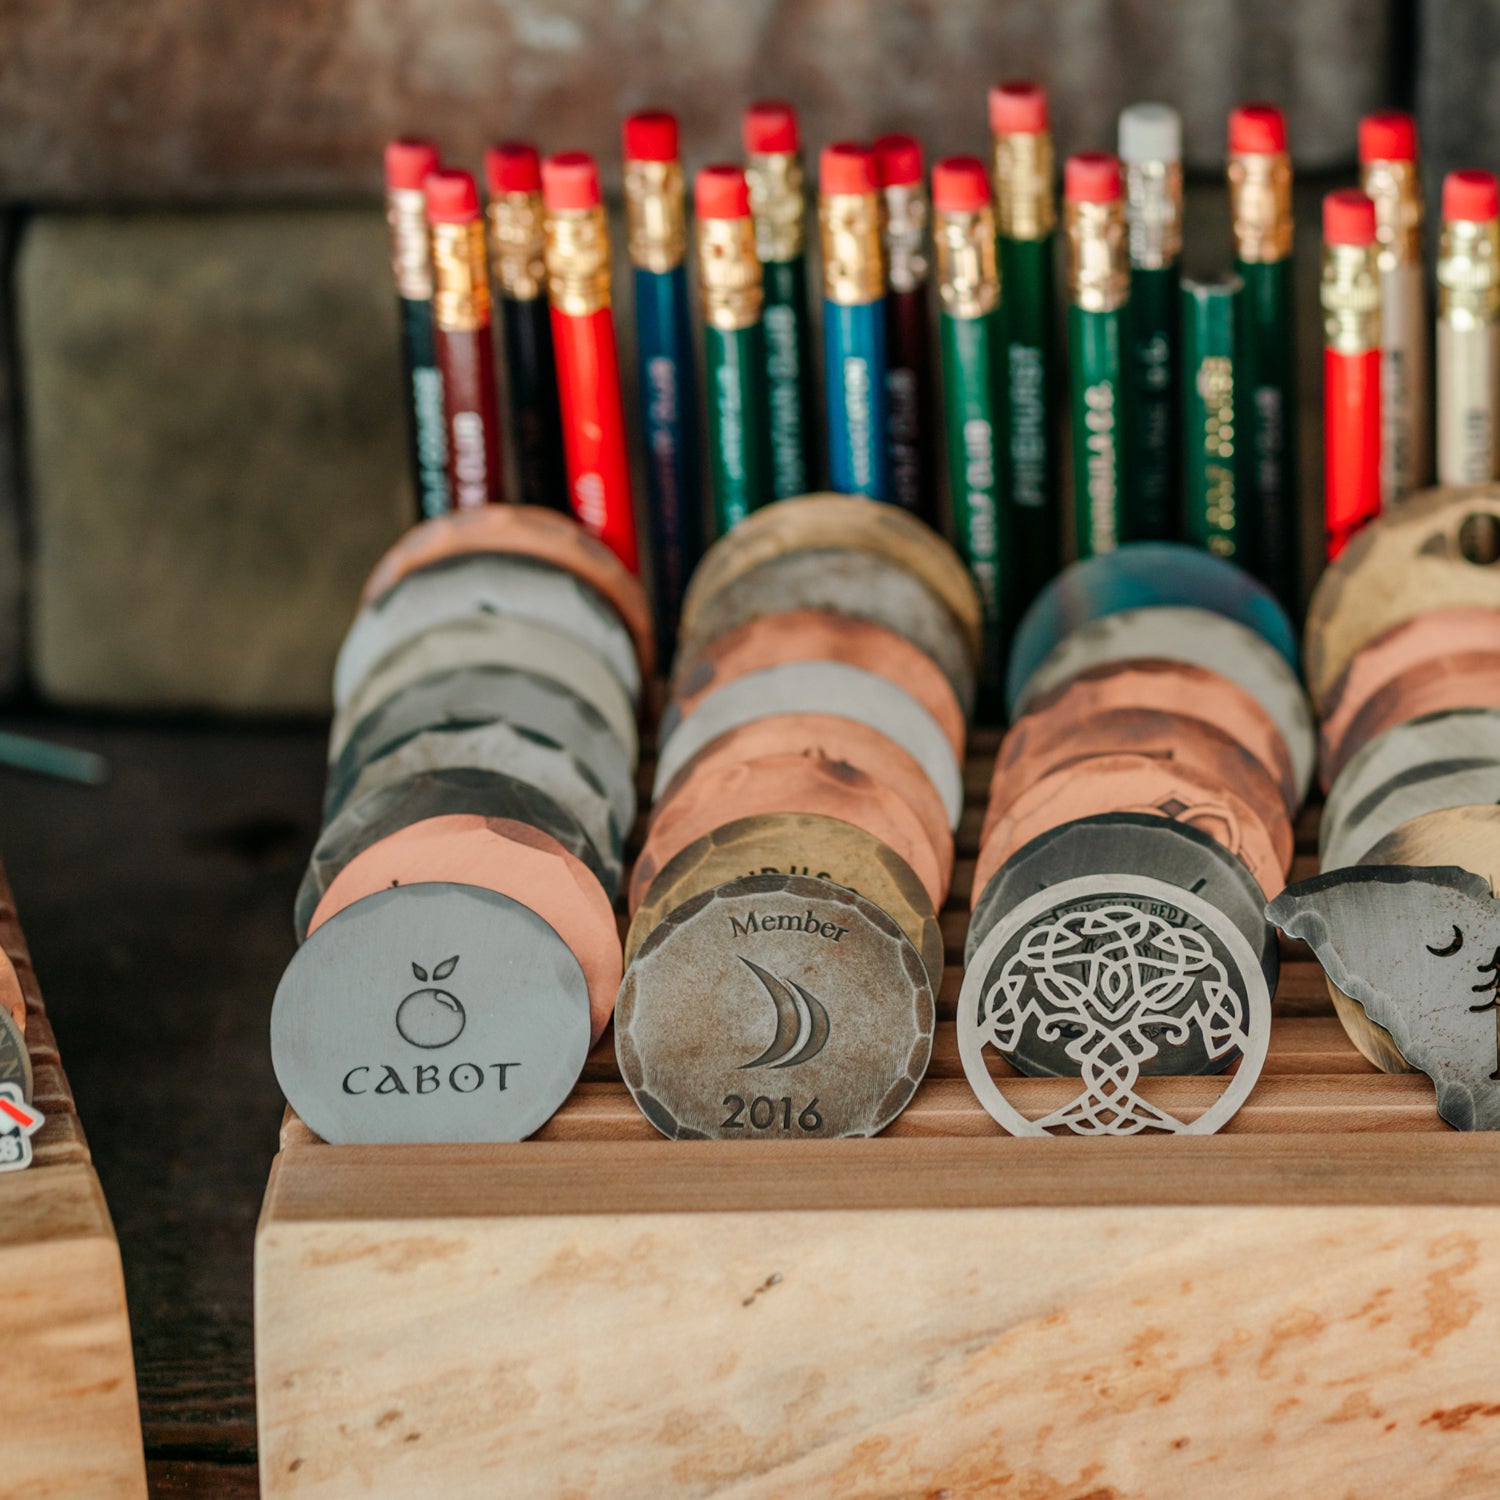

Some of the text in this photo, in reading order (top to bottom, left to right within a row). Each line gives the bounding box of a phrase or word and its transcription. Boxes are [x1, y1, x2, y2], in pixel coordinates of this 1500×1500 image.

[963, 419, 992, 488] CLUB
[728, 910, 849, 942] Member
[342, 1062, 522, 1095] CABOT
[720, 1094, 823, 1131] 2016
